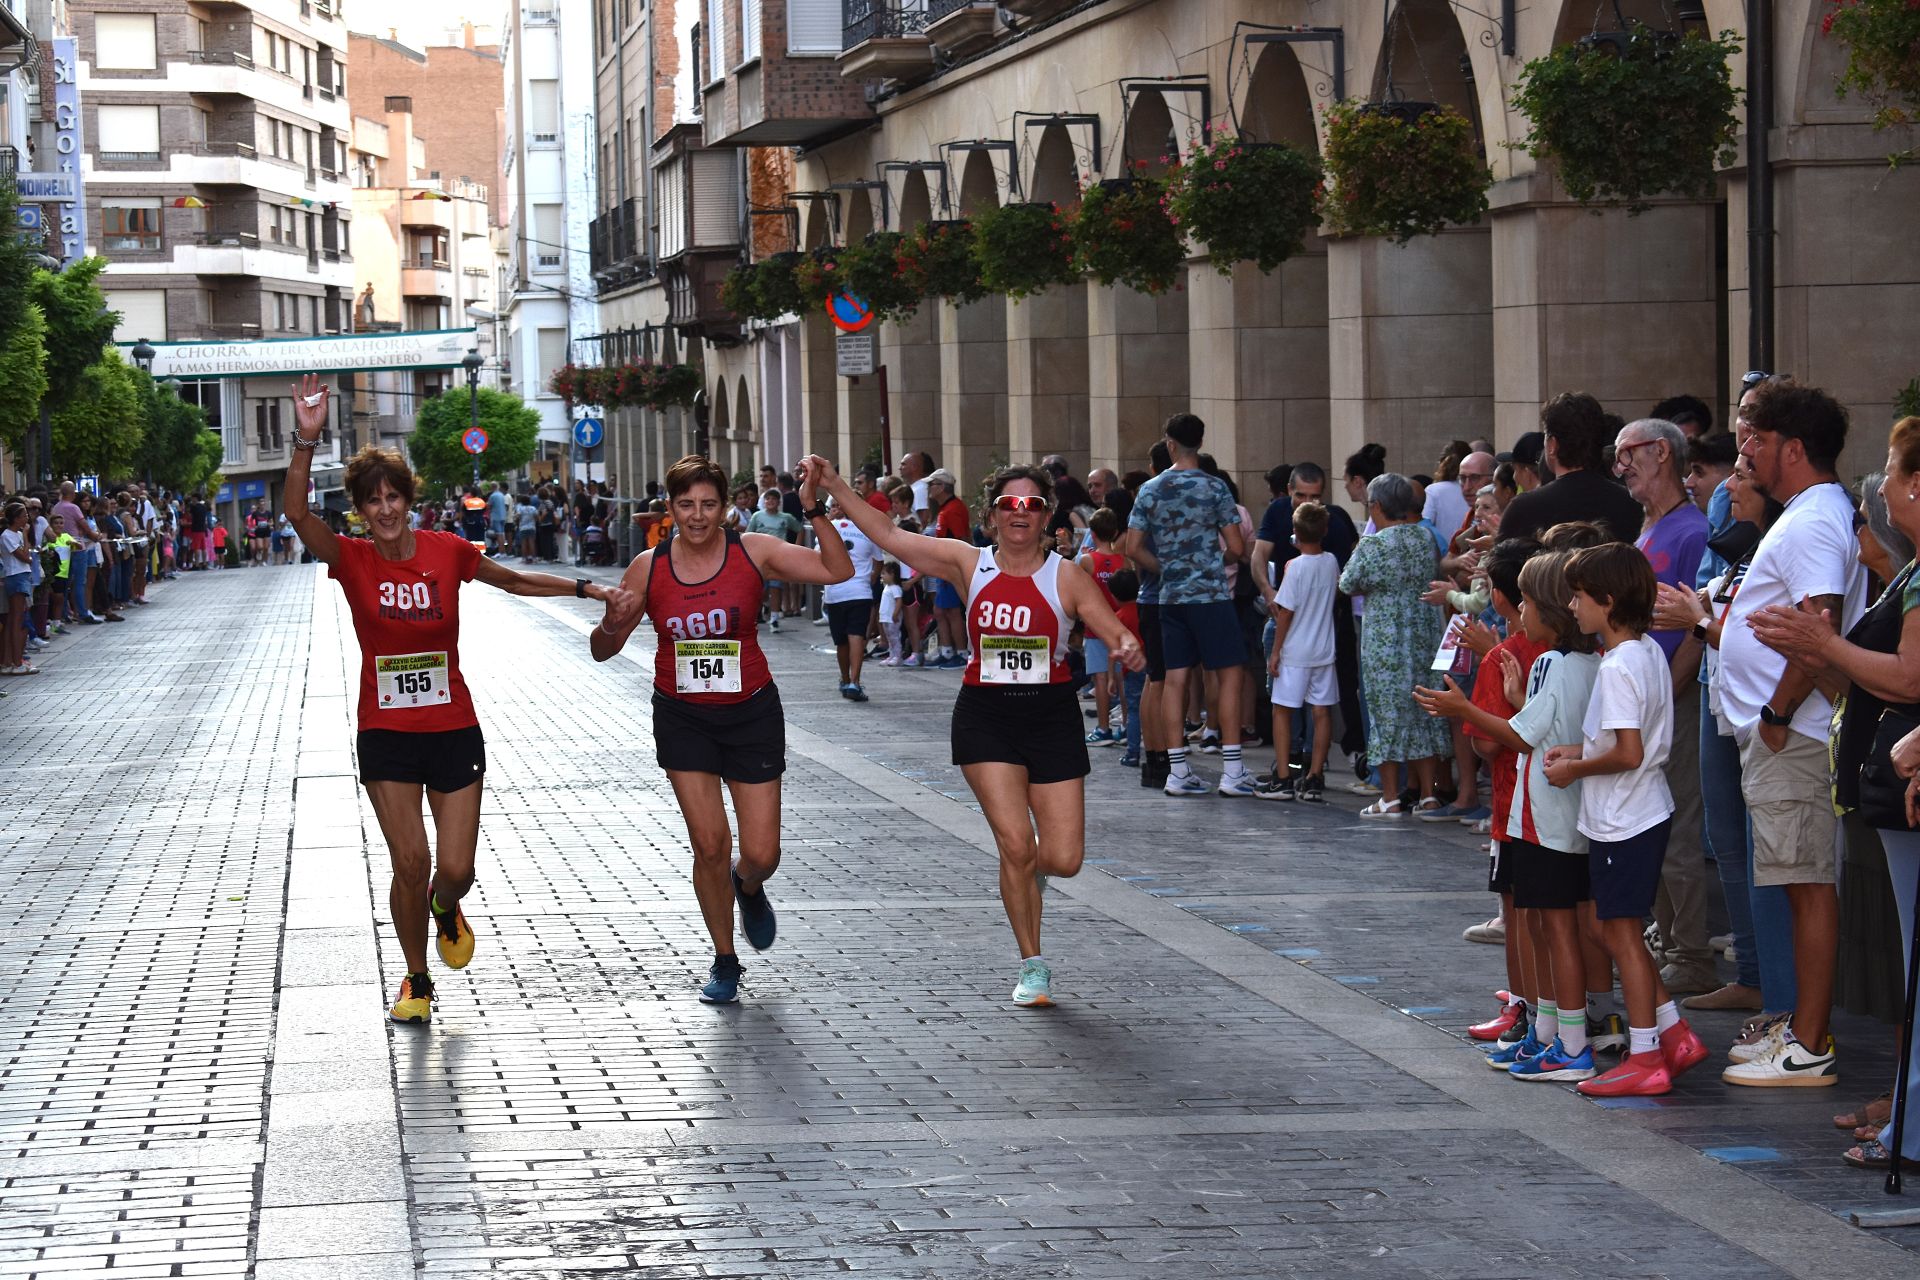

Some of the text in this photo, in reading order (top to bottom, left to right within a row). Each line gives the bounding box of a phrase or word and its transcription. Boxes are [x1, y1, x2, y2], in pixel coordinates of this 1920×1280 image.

[18, 179, 73, 196] MONREAL
[169, 352, 423, 373] LA MAS HERMOSA DEL MUNDO ENTERO
[379, 581, 431, 610] 360
[666, 607, 727, 641] 360
[978, 600, 1032, 633] 360
[690, 658, 724, 679] 154
[997, 650, 1032, 670] 156
[394, 671, 432, 694] 155
